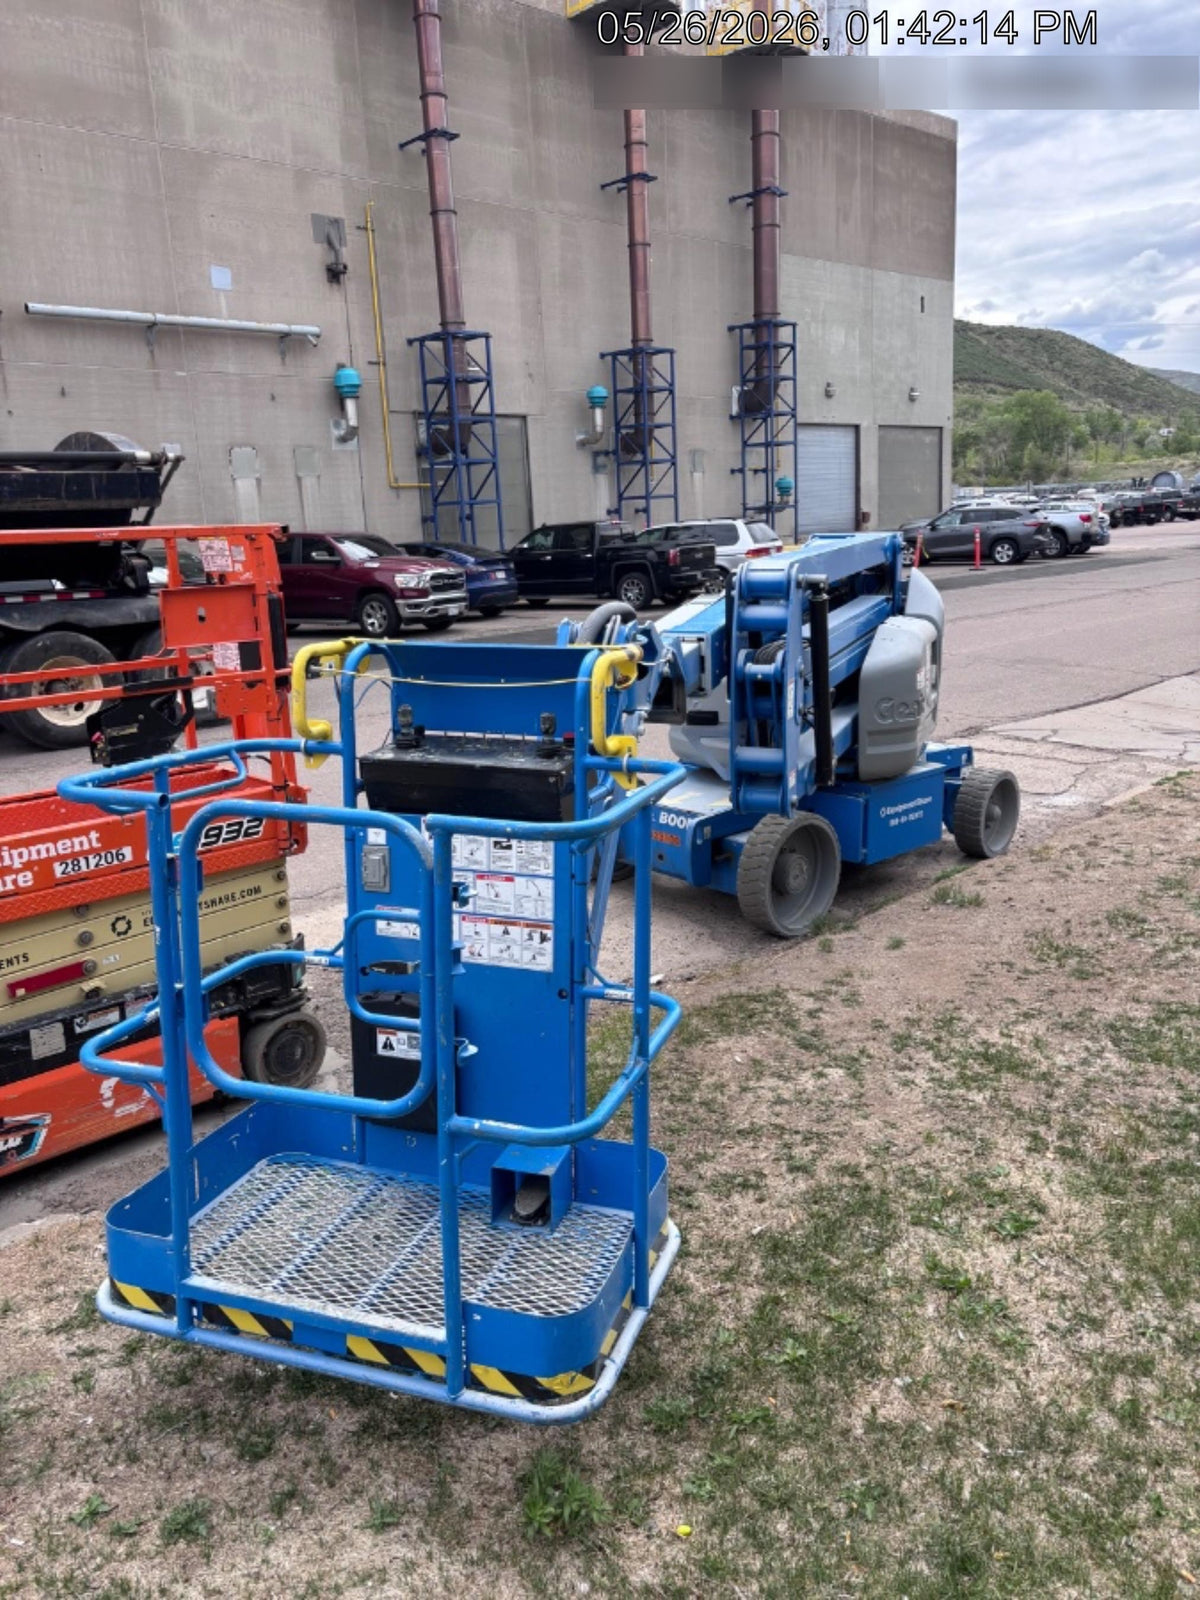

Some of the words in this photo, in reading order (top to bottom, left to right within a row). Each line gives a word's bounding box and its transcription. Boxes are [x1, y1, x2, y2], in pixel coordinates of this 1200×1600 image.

[199, 817, 266, 849] 932
[0, 830, 102, 868] ipment
[59, 848, 126, 876] 281206
[0, 952, 30, 970] ENTS
